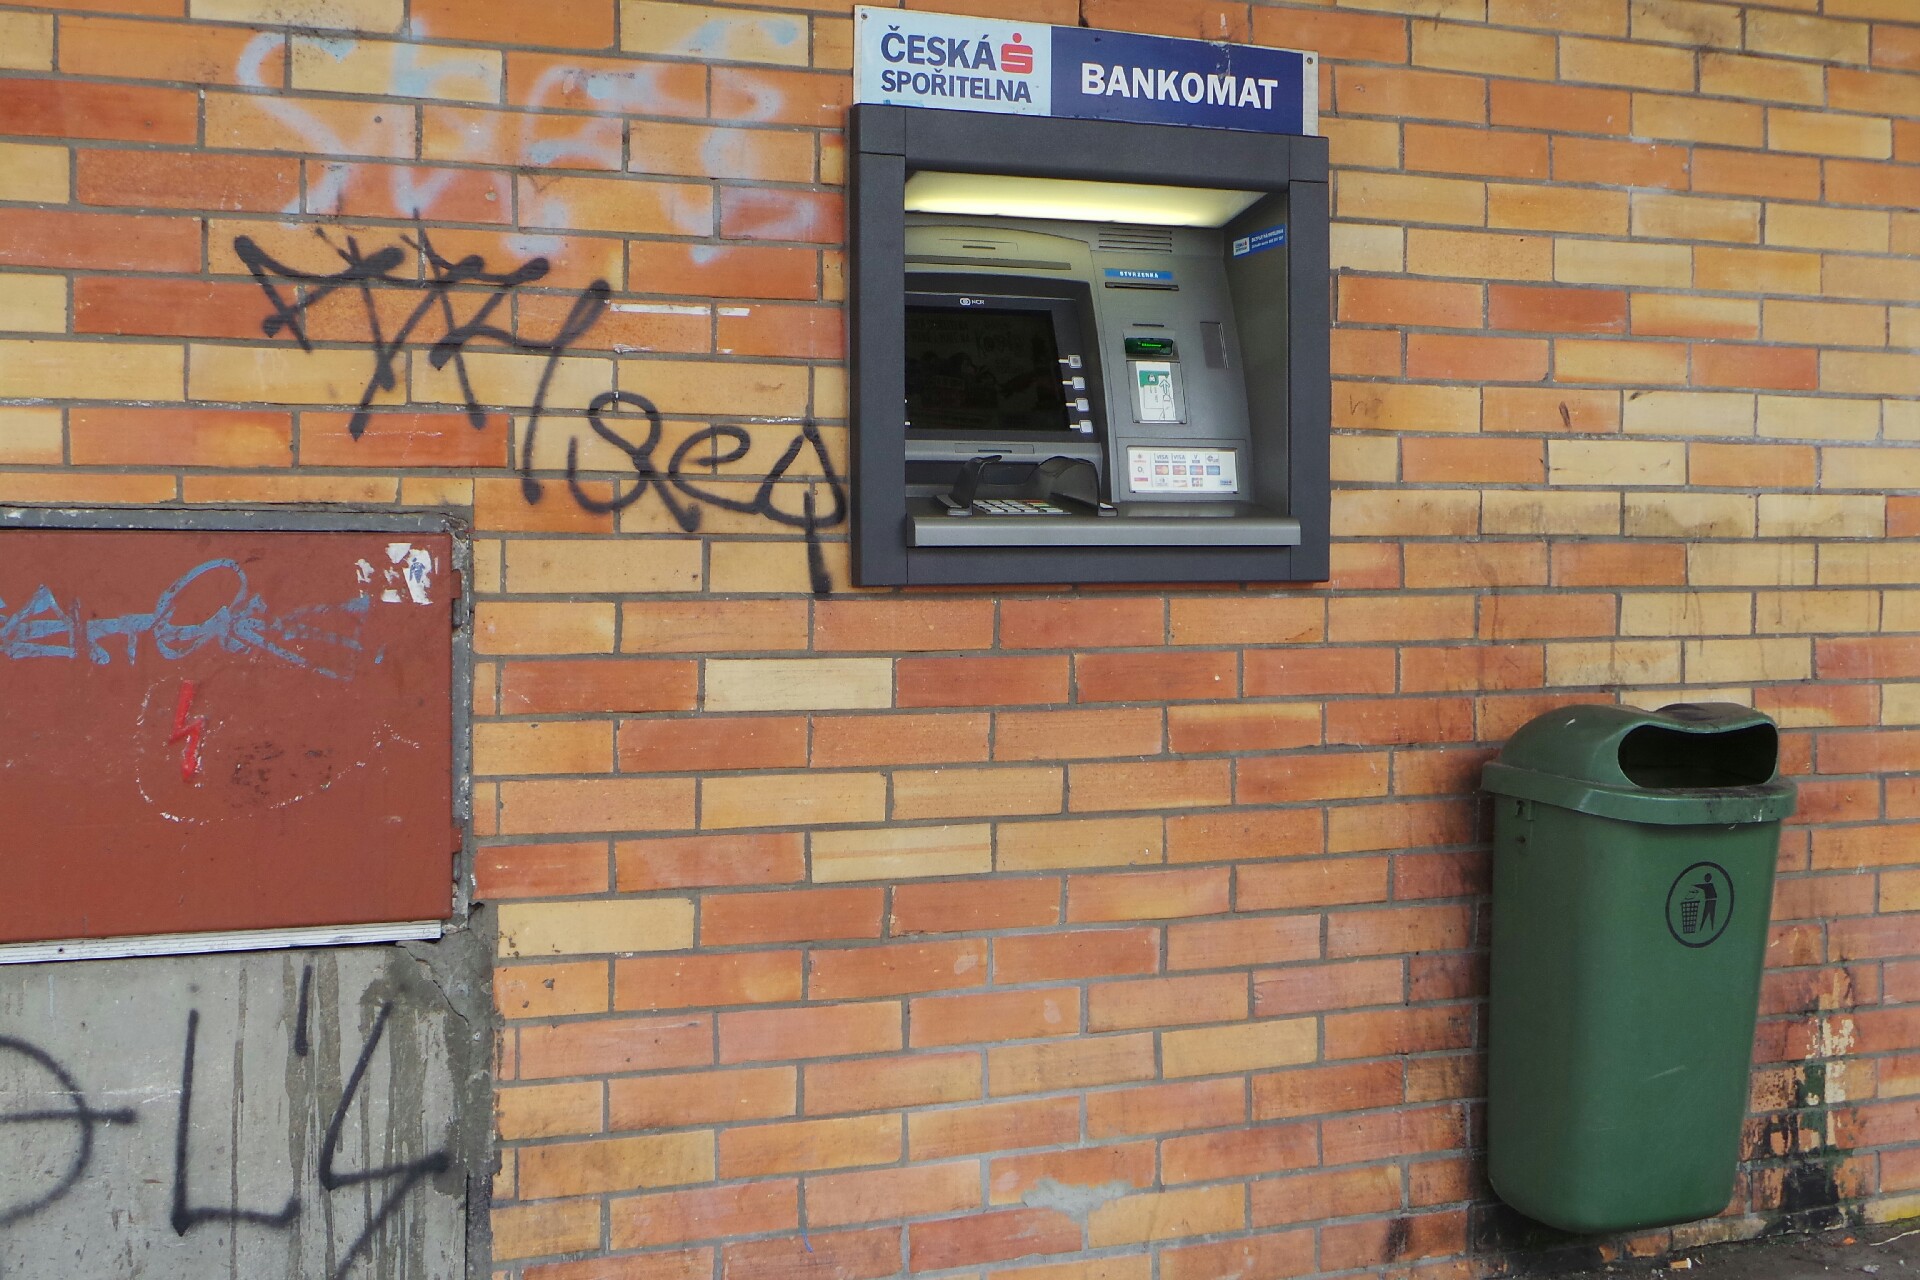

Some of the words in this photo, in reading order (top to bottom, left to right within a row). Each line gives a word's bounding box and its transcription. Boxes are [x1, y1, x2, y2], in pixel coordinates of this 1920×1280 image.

[881, 25, 997, 71] ČESKÁ
[881, 68, 1032, 104] SPOŘITELNA
[1081, 62, 1279, 110] BANKOMAT
